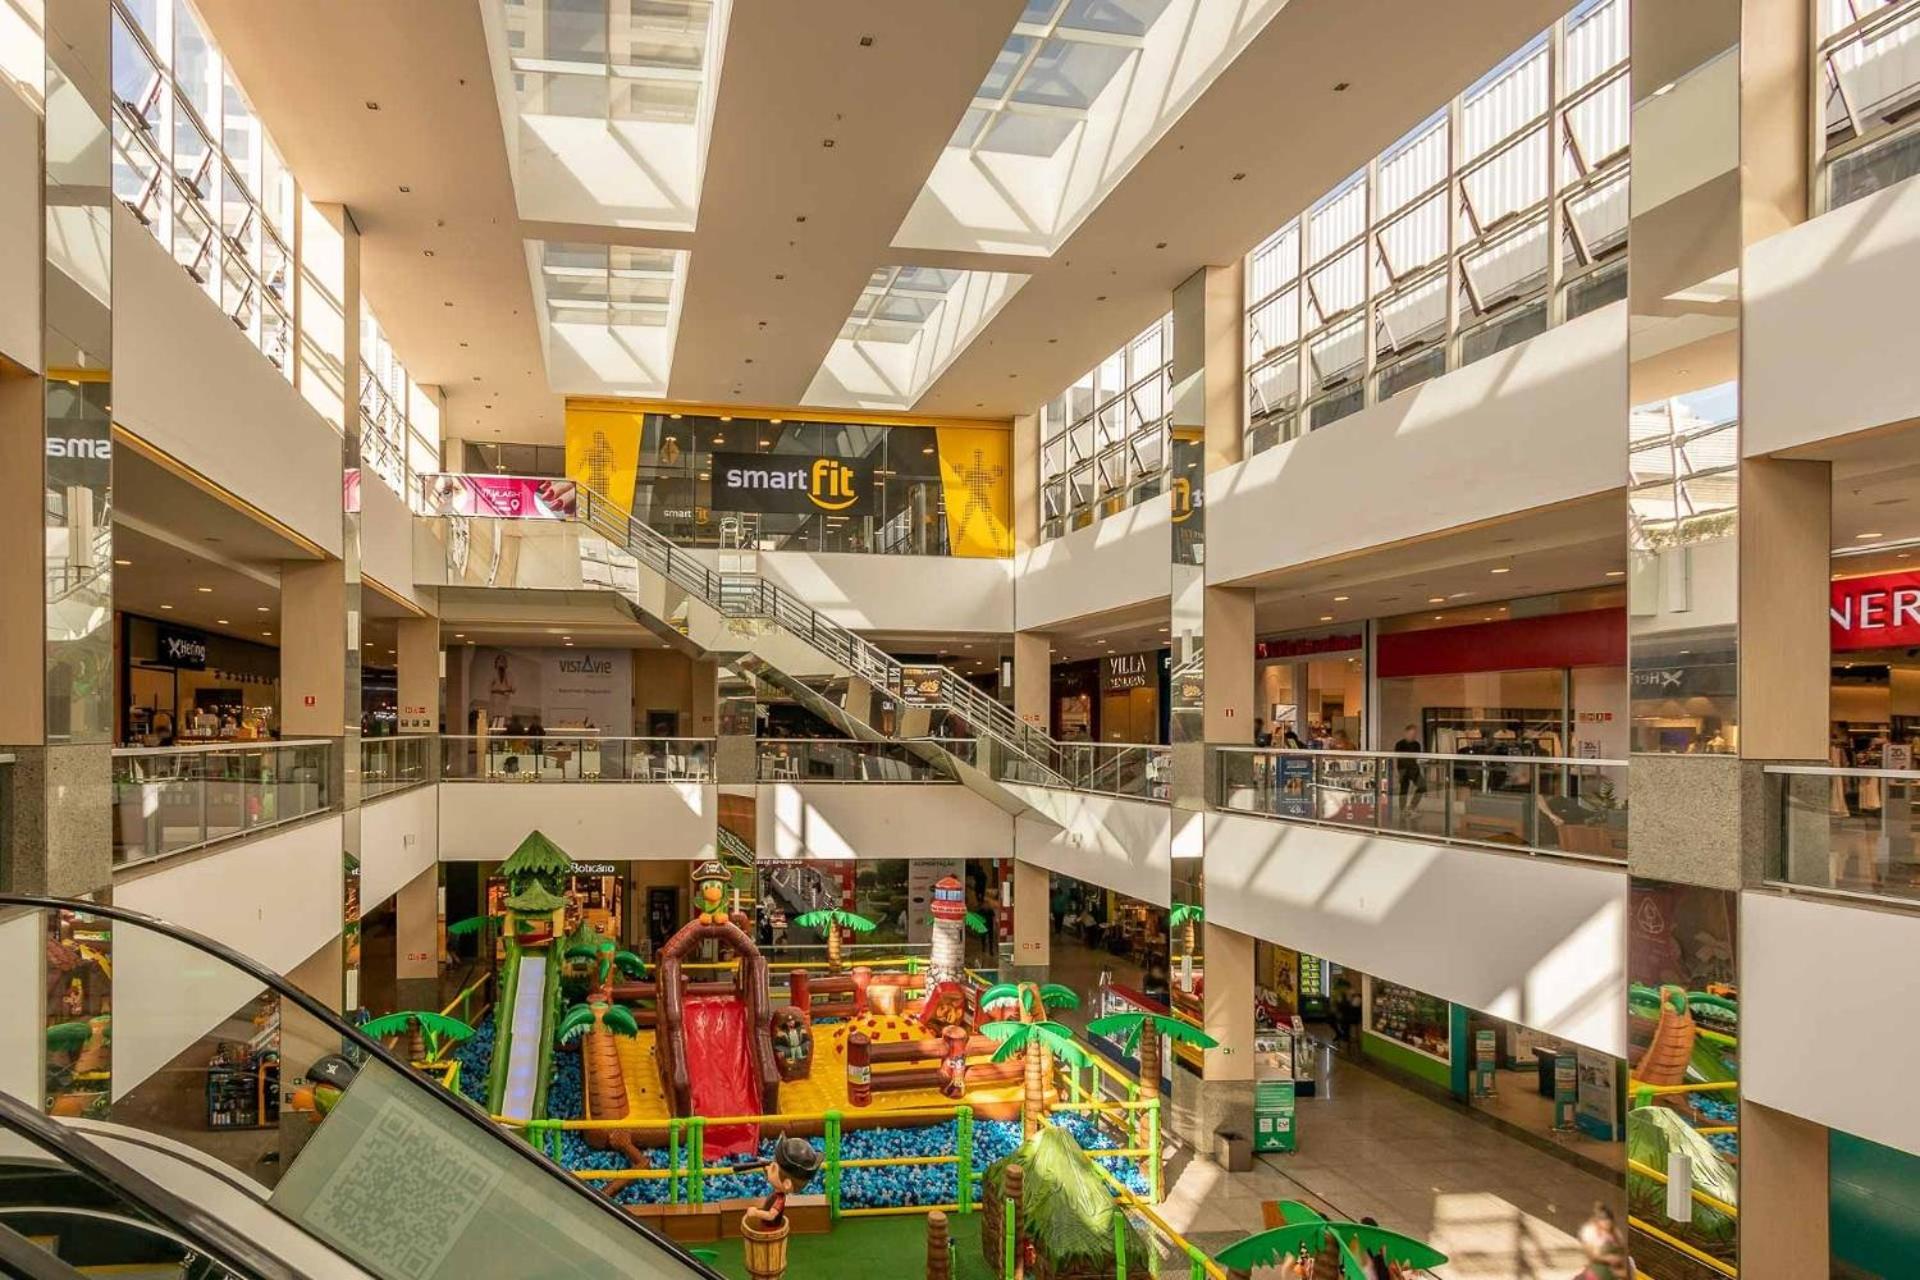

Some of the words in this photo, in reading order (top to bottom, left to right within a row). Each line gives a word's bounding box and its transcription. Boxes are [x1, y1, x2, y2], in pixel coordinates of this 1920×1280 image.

[727, 468, 808, 491] smart
[812, 458, 856, 497] fit
[1829, 589, 1920, 631] NER
[1110, 655, 1147, 675] VILLA
